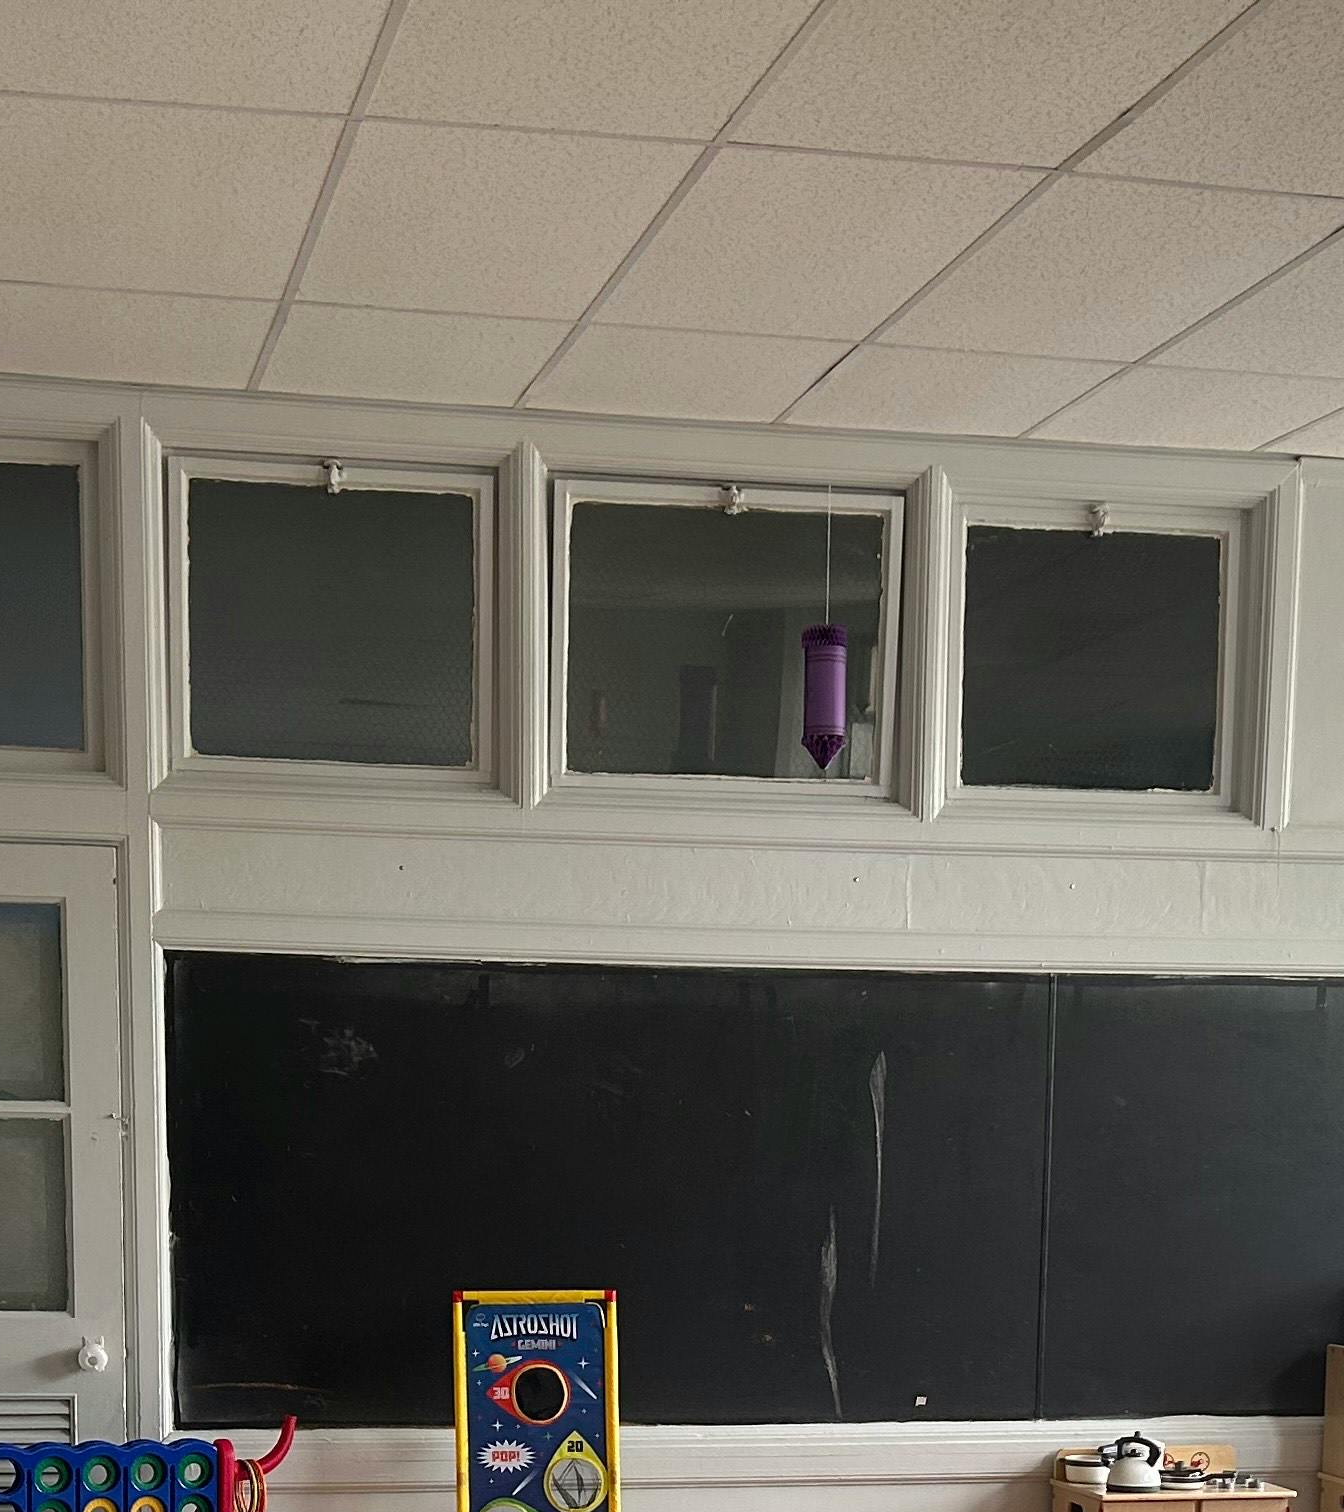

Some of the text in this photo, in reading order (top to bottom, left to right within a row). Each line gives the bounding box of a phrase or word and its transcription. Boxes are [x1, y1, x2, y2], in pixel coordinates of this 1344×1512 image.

[490, 1312, 580, 1341] ASTROSHOT
[517, 1339, 557, 1350] GEMINI
[567, 1440, 584, 1453] 20
[491, 1450, 522, 1462] POP!
